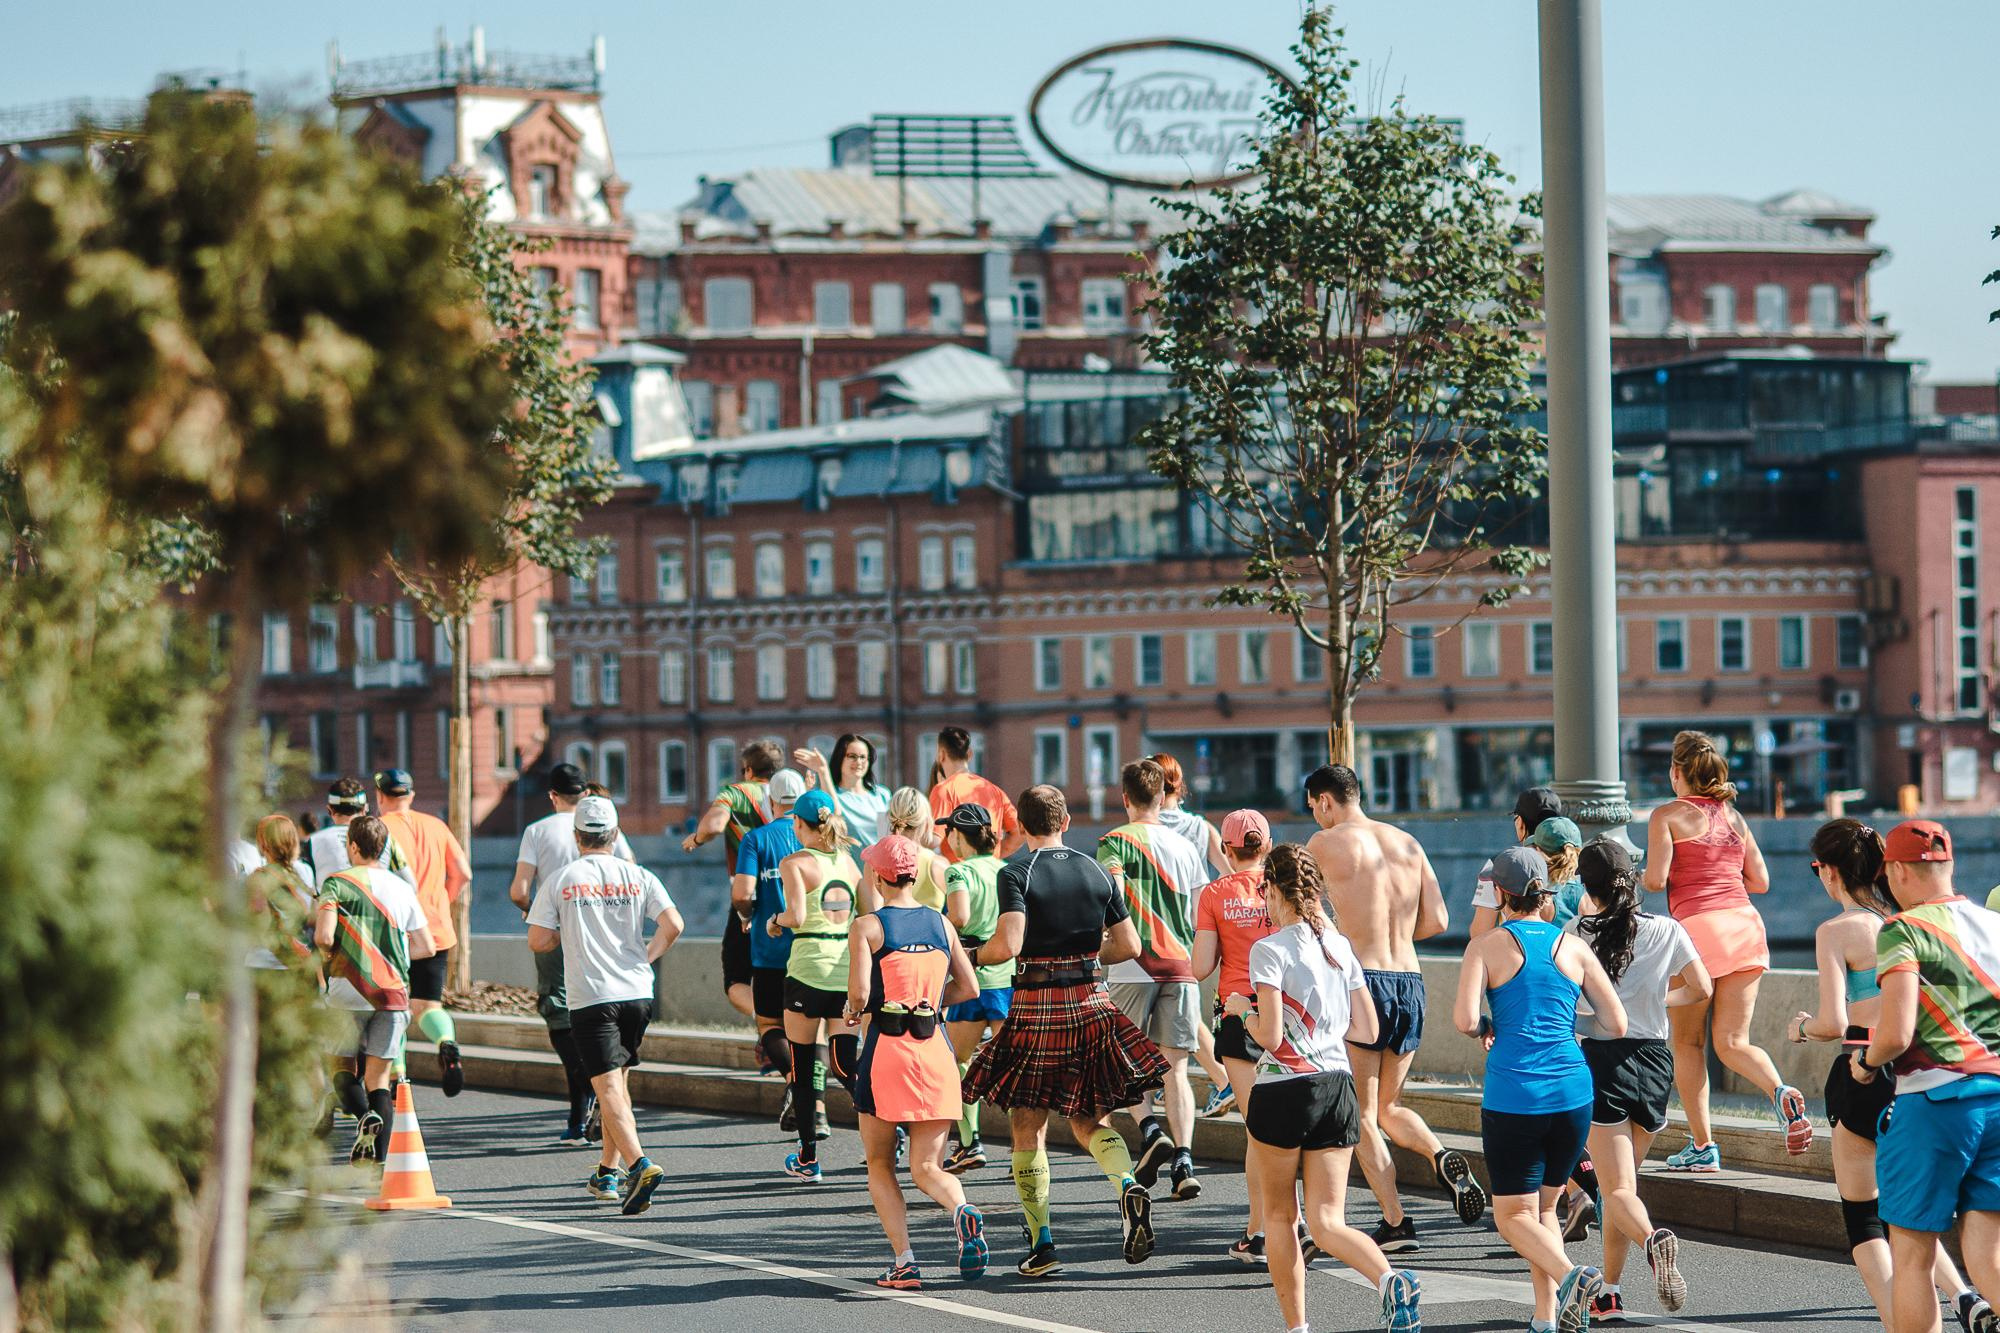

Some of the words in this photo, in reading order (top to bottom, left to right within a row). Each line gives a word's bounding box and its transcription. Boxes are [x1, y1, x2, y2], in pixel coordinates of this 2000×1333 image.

[1072, 67, 1256, 130] Красный
[562, 883, 640, 900] STRABAG
[605, 898, 631, 906] WORK
[1223, 898, 1255, 908] HALF
